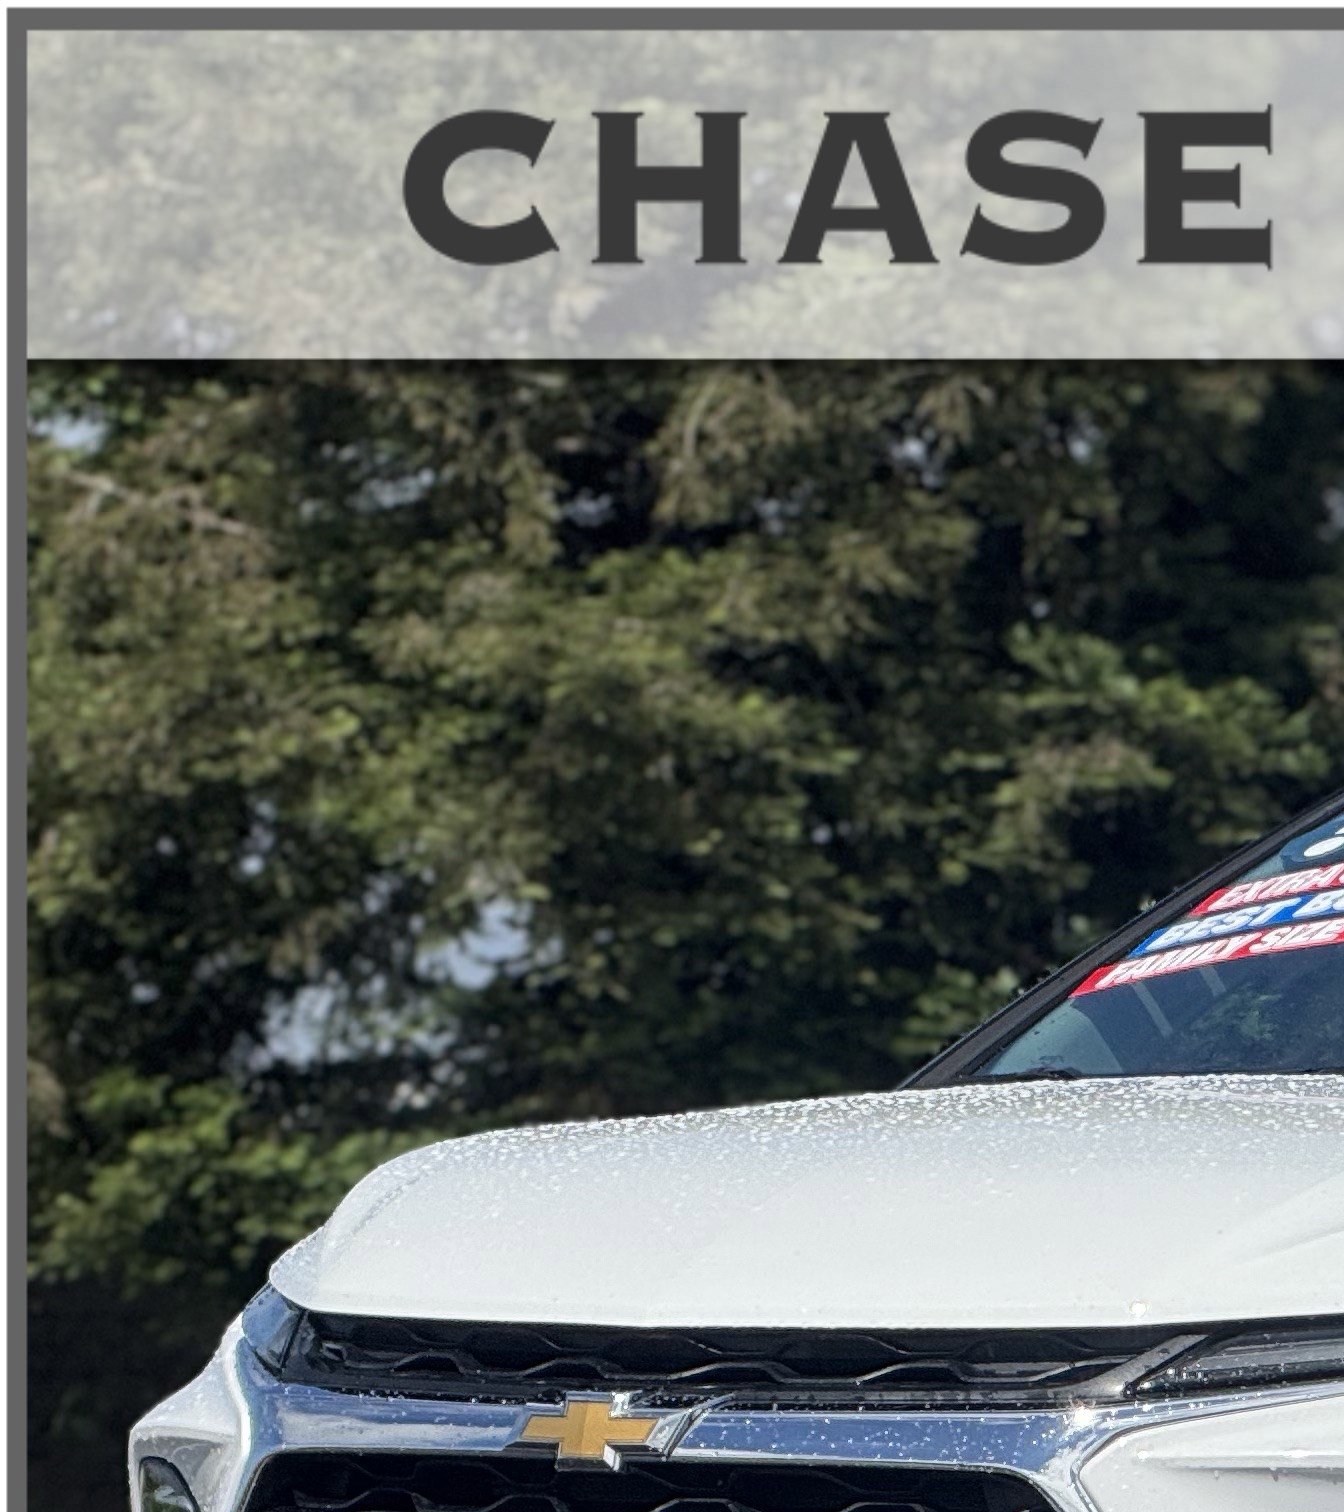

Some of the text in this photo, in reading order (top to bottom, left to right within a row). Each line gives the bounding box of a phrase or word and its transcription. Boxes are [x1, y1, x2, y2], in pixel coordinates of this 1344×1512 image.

[1207, 863, 1342, 912] EXTRA
[1145, 899, 1300, 952] BEST
[1095, 932, 1262, 990] FAMILY
